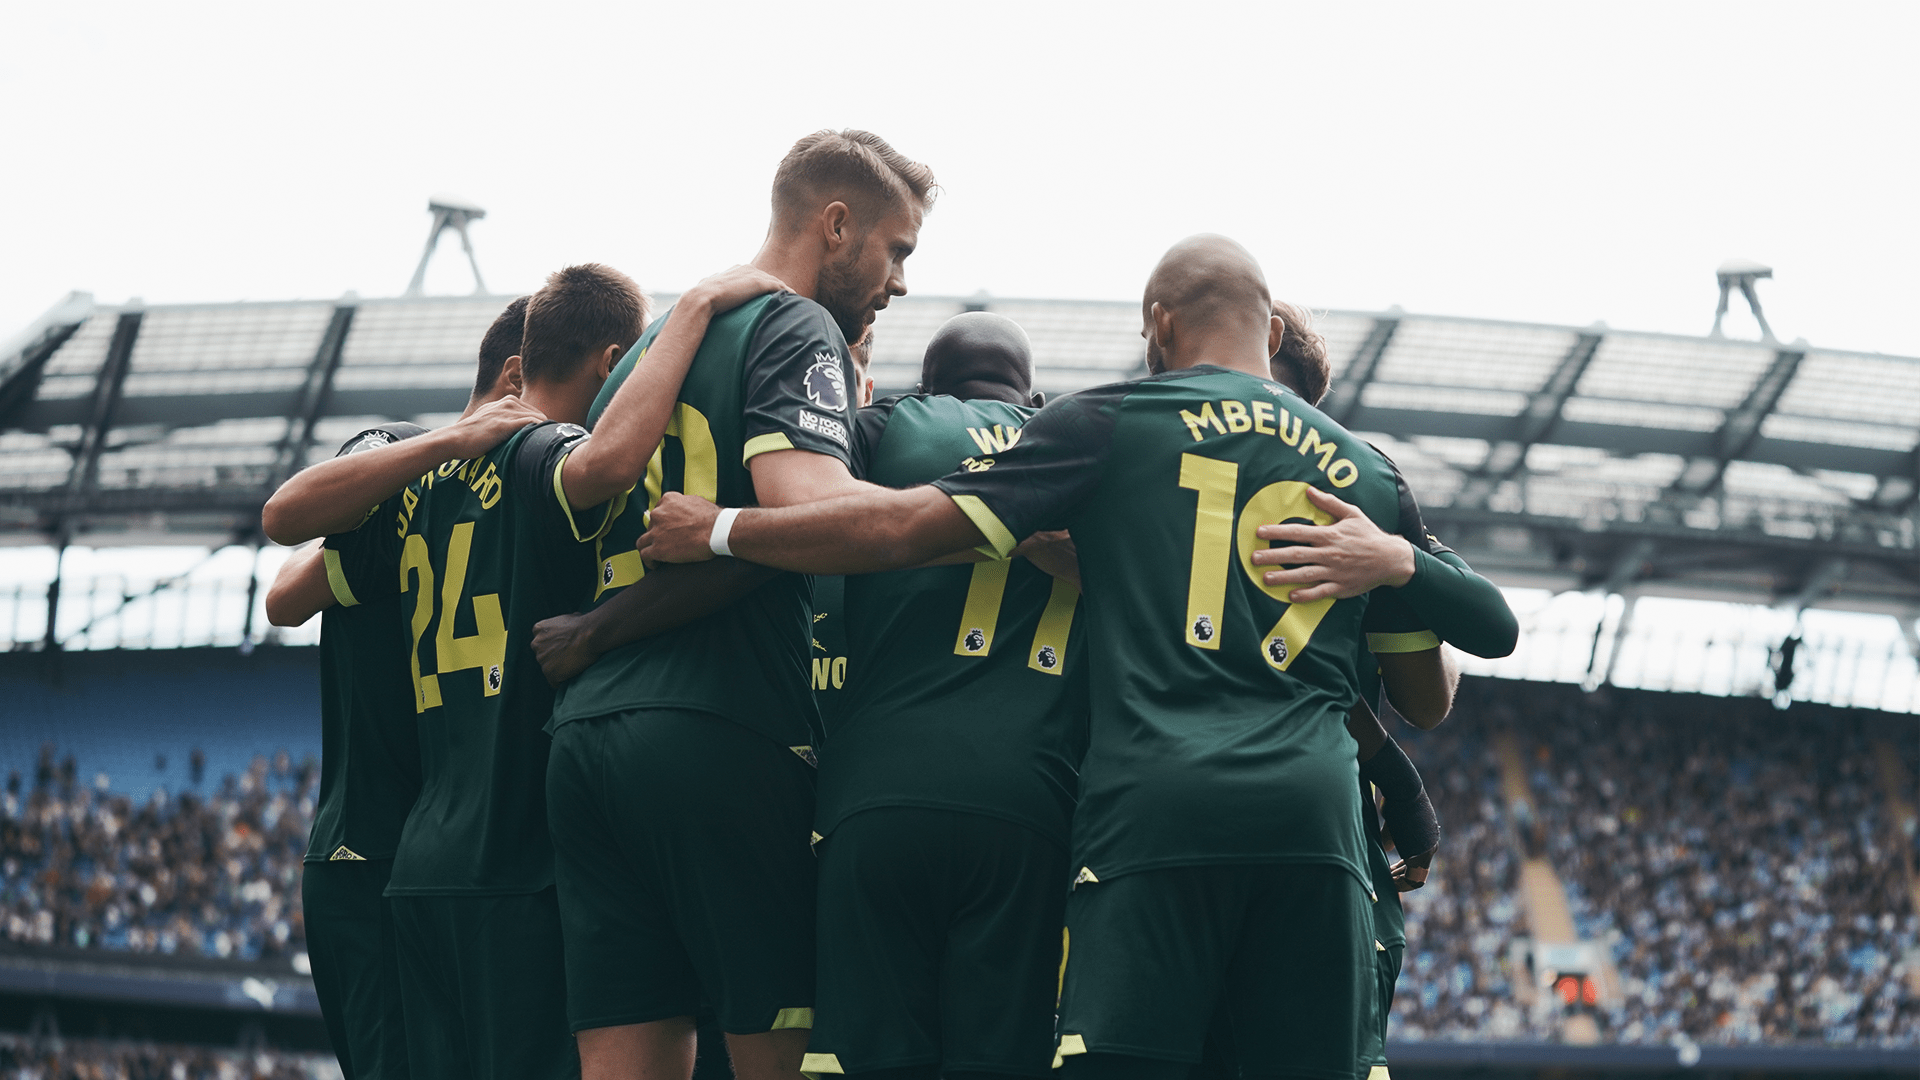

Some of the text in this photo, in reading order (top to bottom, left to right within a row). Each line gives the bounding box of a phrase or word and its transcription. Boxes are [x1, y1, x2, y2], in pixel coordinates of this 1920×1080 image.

[800, 409, 848, 439] No room
[1179, 400, 1359, 488] MBEUMO
[400, 521, 508, 714] 24
[1178, 452, 1337, 672] 19
